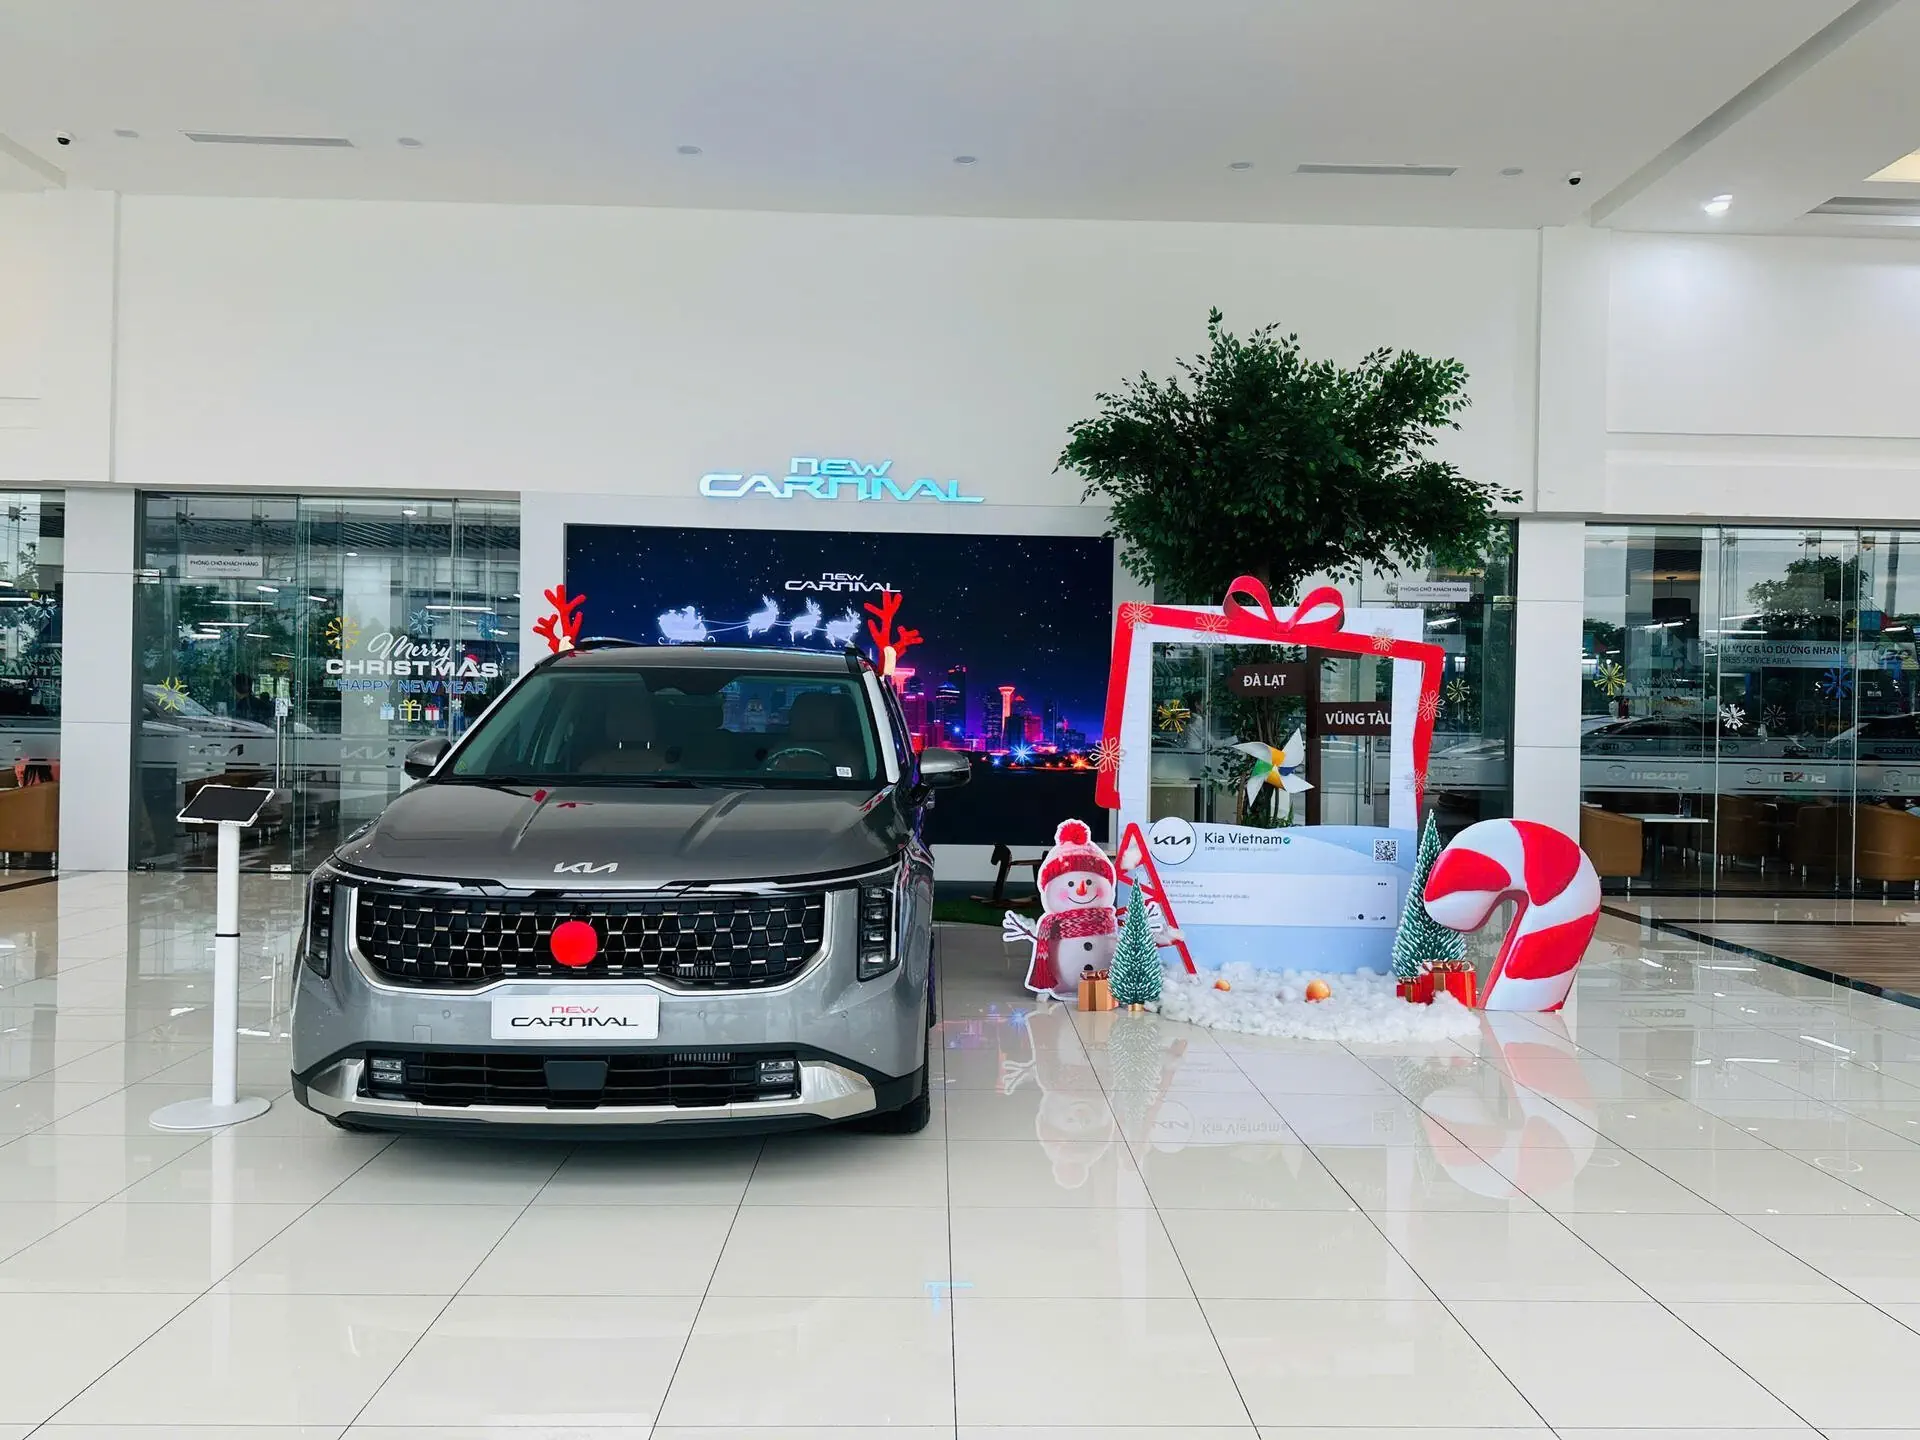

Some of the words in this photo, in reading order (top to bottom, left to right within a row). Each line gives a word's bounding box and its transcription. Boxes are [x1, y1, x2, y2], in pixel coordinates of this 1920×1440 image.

[791, 456, 893, 477] NEW
[699, 473, 986, 503] CARNIVAL
[821, 572, 865, 582] NEW
[784, 580, 902, 593] CARNIVAL
[367, 632, 453, 669] Merry
[325, 659, 499, 679] CHRISTMAS
[337, 679, 395, 693] HAPPY
[397, 679, 440, 694] NEW
[441, 680, 488, 695] YEAR
[1243, 671, 1262, 687] ĐÀ
[1263, 673, 1287, 689] LẠT
[1325, 710, 1365, 726] VŨNG
[1367, 711, 1392, 726] TÀU
[1153, 835, 1191, 846] KIA
[1203, 832, 1225, 844] Kia
[1228, 833, 1282, 845] Vietnam
[553, 861, 619, 874] KIA
[551, 1005, 599, 1014] NEW
[511, 1016, 639, 1028] CARNIVAL
